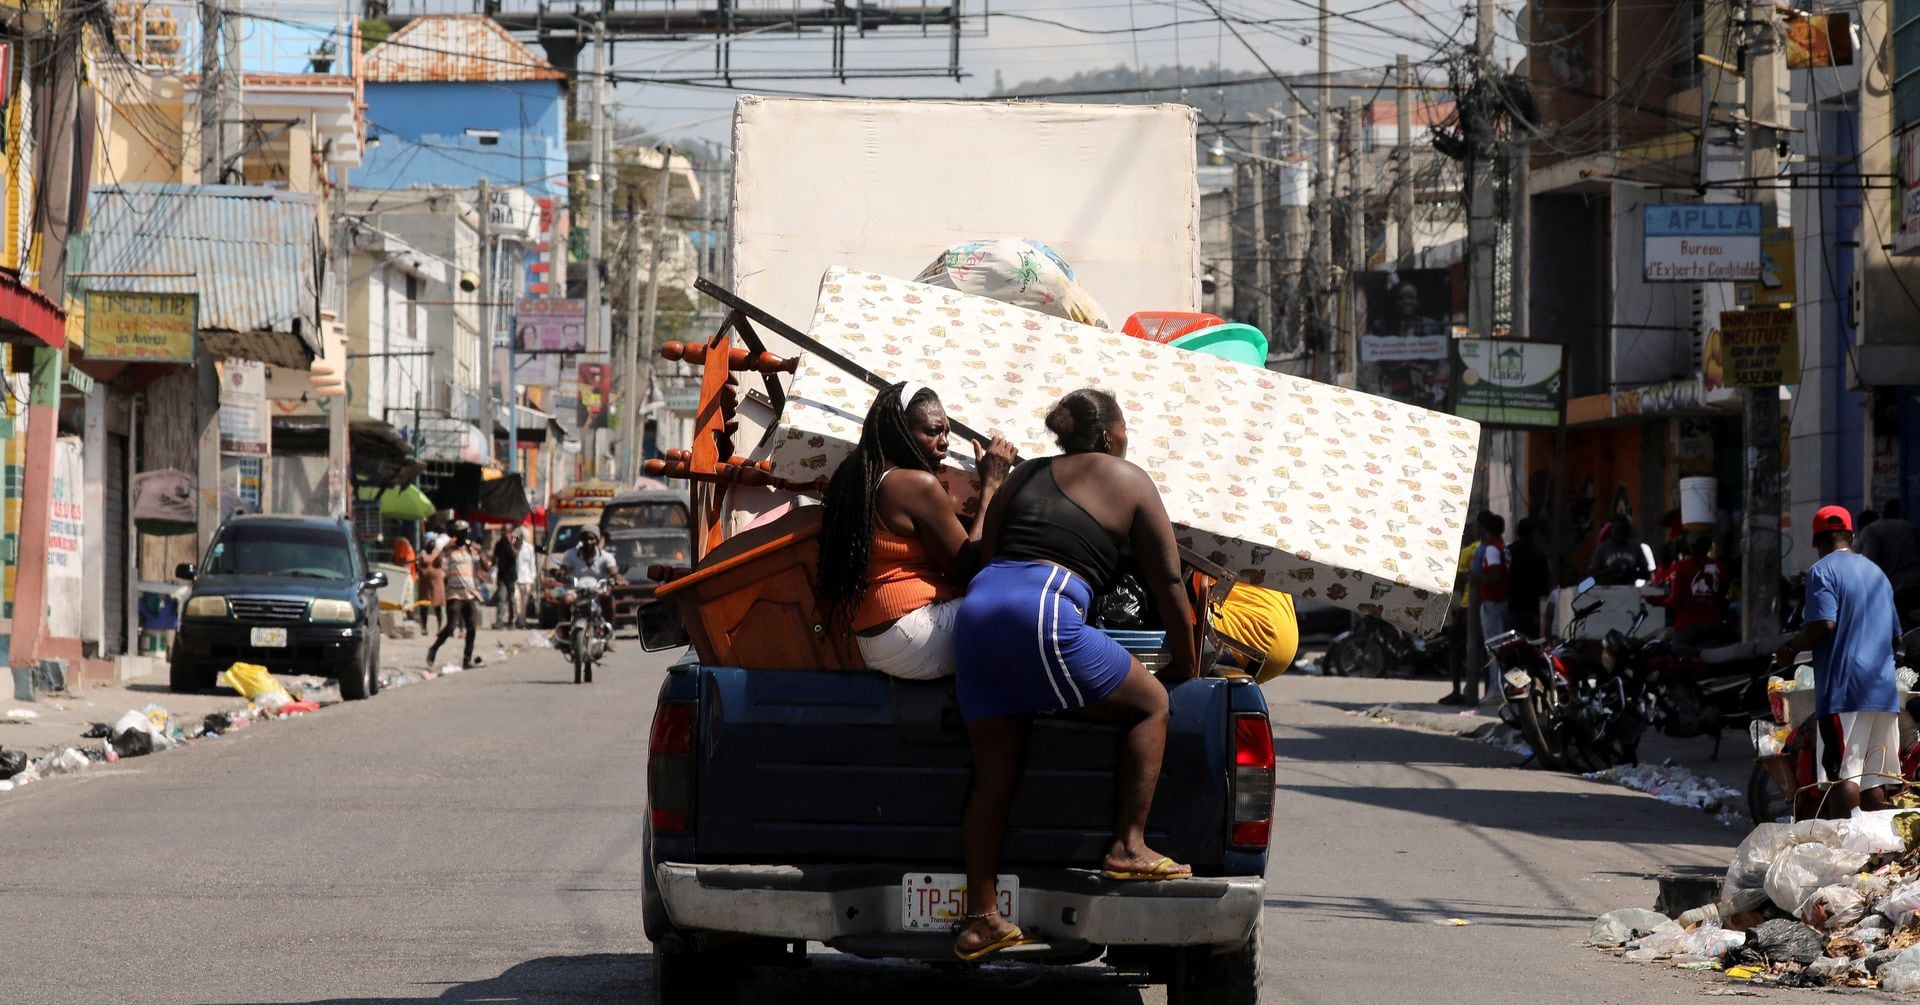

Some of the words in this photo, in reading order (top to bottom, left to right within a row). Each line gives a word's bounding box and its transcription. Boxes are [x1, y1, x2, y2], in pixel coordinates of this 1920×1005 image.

[1667, 208, 1754, 230] APLLA
[1680, 240, 1723, 256] Bureau
[1720, 310, 1793, 328] INNOVATION
[1723, 327, 1788, 345] INSTITUTE
[1492, 367, 1527, 385] Lakay
[917, 889, 1012, 917] TP-503
